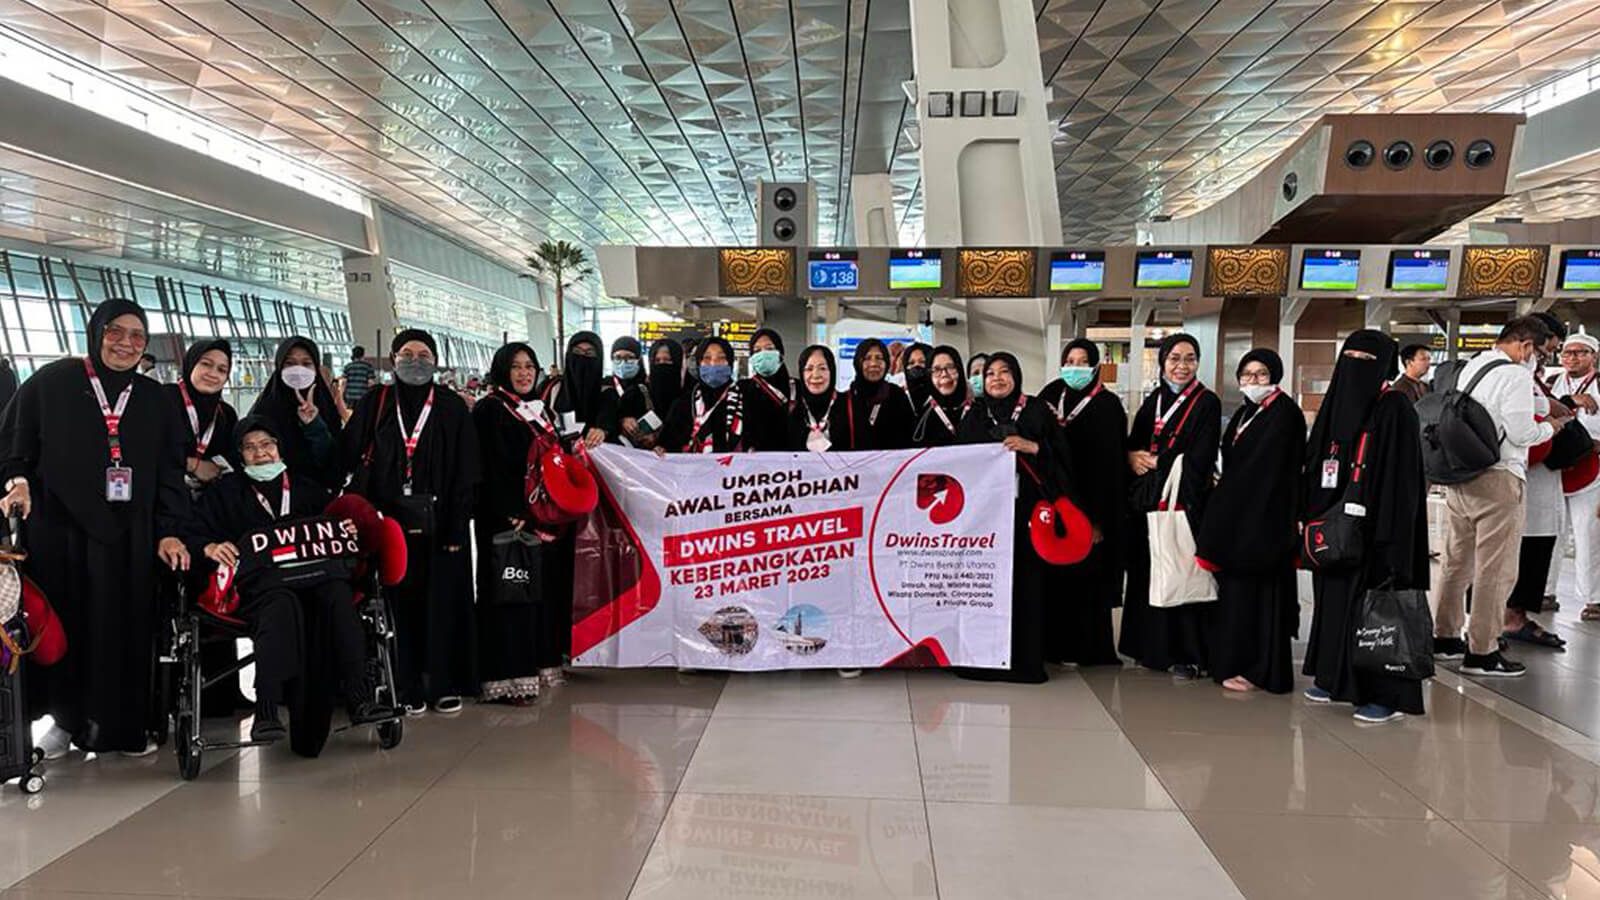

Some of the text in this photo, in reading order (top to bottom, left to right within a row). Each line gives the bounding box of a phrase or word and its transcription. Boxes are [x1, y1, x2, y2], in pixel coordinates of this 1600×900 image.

[831, 271, 854, 284] 138
[723, 470, 802, 489] UMROH
[664, 475, 859, 518] AWAL RAMADHAN
[725, 504, 793, 523] BERSAMA
[680, 517, 848, 558] DWINS TRAVEL
[885, 531, 996, 548] DwinsTravel
[670, 542, 854, 585] KEBERANGKATAN
[694, 564, 830, 599] 23 MARET 2023
[969, 600, 994, 608] Group
